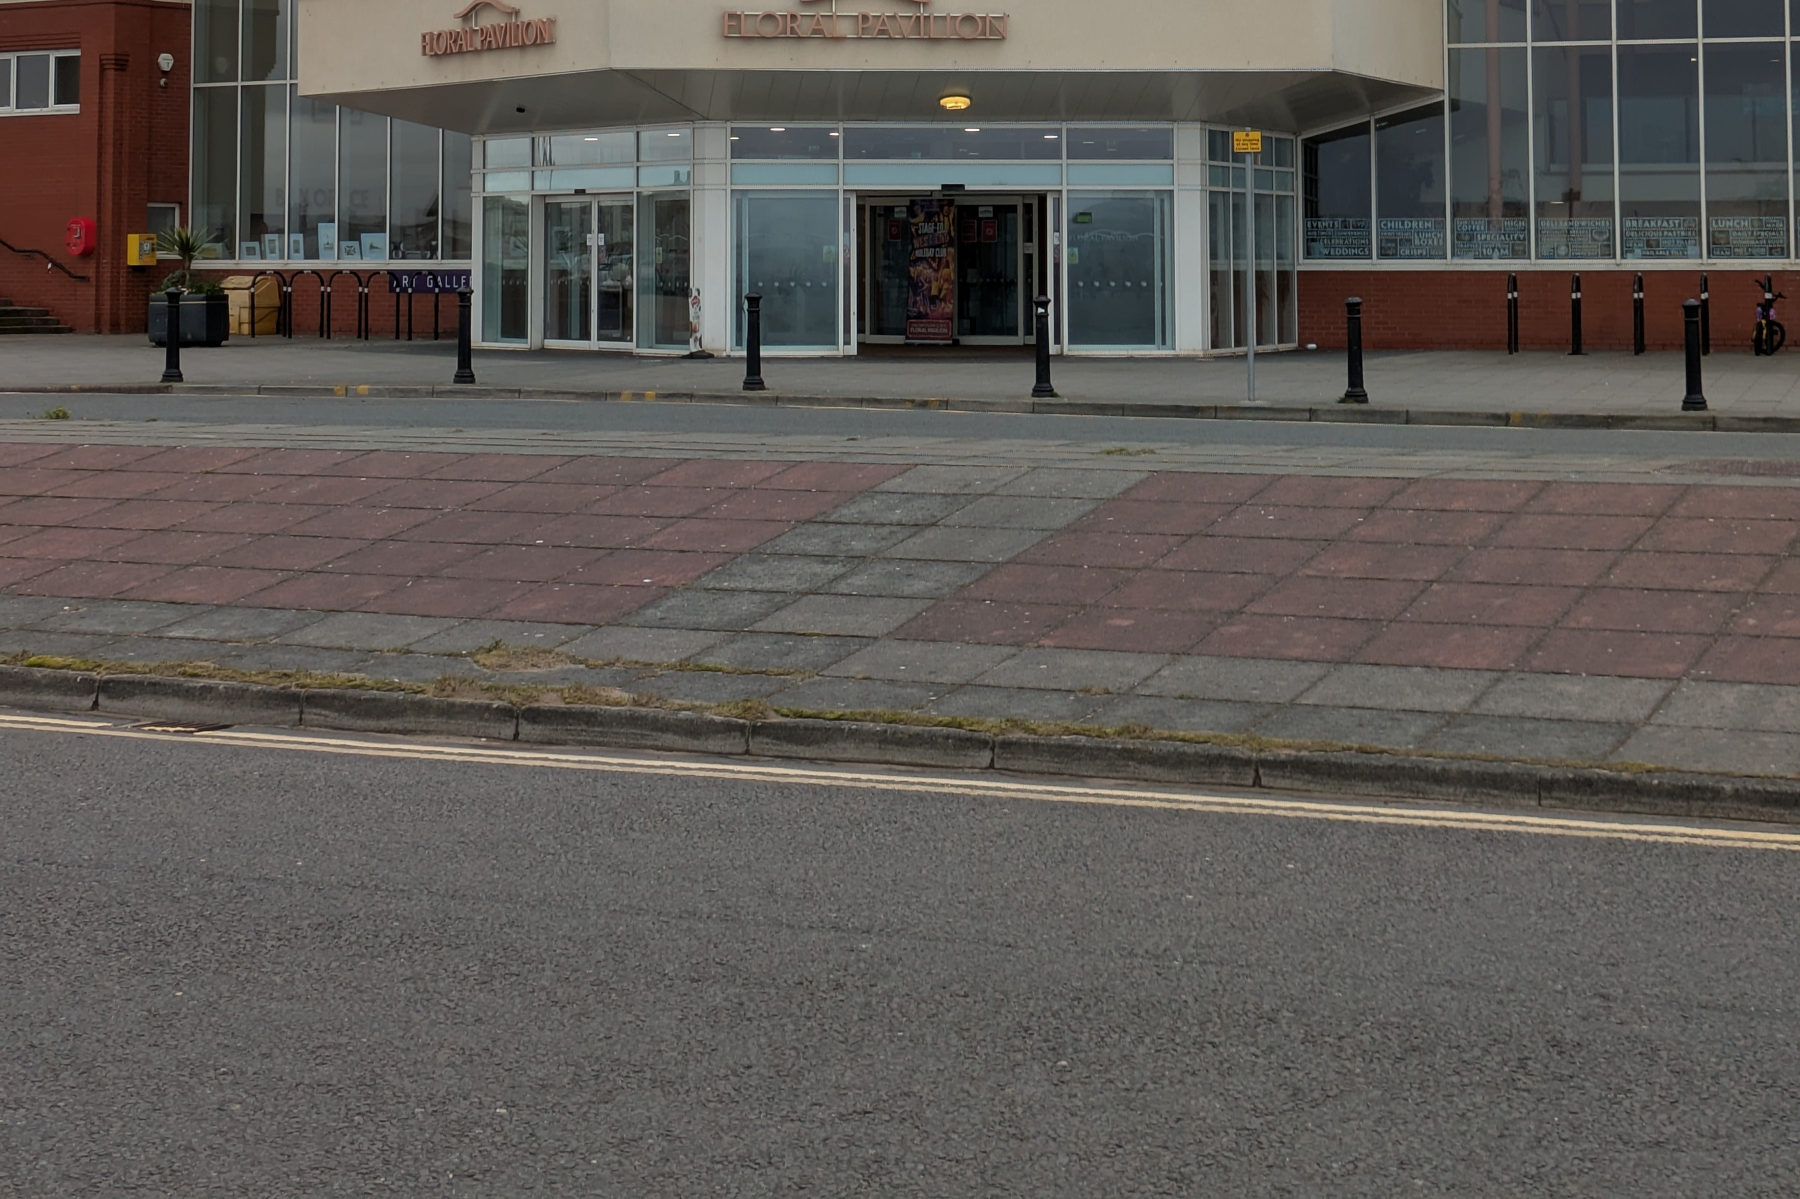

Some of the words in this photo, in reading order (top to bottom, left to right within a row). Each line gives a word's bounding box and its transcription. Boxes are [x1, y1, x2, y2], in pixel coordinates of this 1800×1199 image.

[723, 11, 846, 38] FLORAL
[857, 11, 1008, 39] PAVILION
[421, 27, 475, 56] FLORAL
[478, 18, 553, 50] PAVILION
[1307, 220, 1339, 228] EVENTS
[1381, 221, 1431, 229] CHILDREN
[1625, 220, 1680, 228] BREAKFAST
[1712, 219, 1749, 228] LUNCH
[1415, 231, 1443, 239] LUNCH
[1415, 238, 1443, 246] BOXES
[915, 248, 934, 258] HOLIDAY
[935, 247, 947, 257] CLUB
[1323, 247, 1369, 256] WEDDINGS
[1400, 248, 1426, 256] CRISPS
